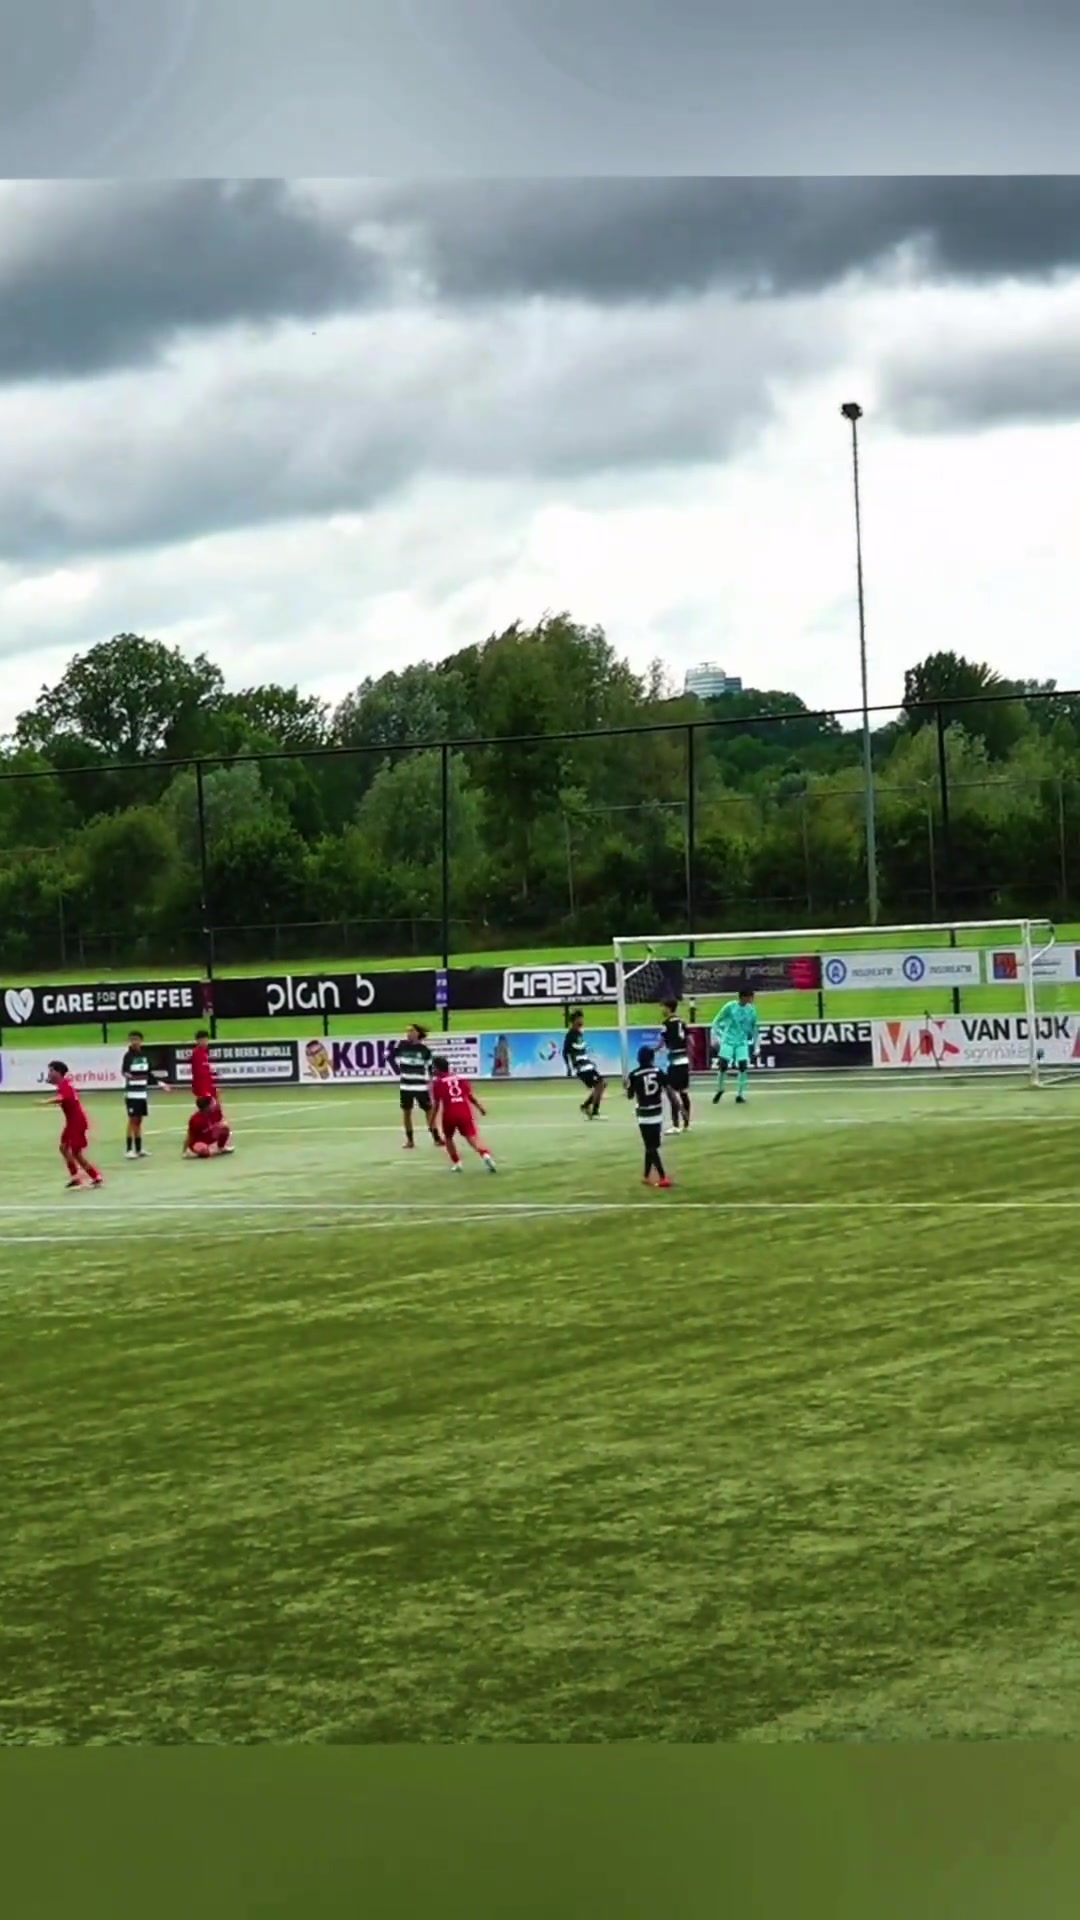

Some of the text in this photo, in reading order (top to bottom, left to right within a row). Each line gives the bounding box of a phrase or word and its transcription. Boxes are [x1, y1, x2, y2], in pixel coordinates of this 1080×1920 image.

[42, 992, 95, 1014] CARE
[118, 988, 193, 1010] COFFEE
[266, 975, 340, 1015] plan
[758, 1022, 872, 1045] ESQUARE
[961, 1016, 1071, 1041] VAN DIJK
[261, 1045, 292, 1057] ZWOLLE
[447, 1079, 462, 1096] 8
[643, 1072, 659, 1096] 15
